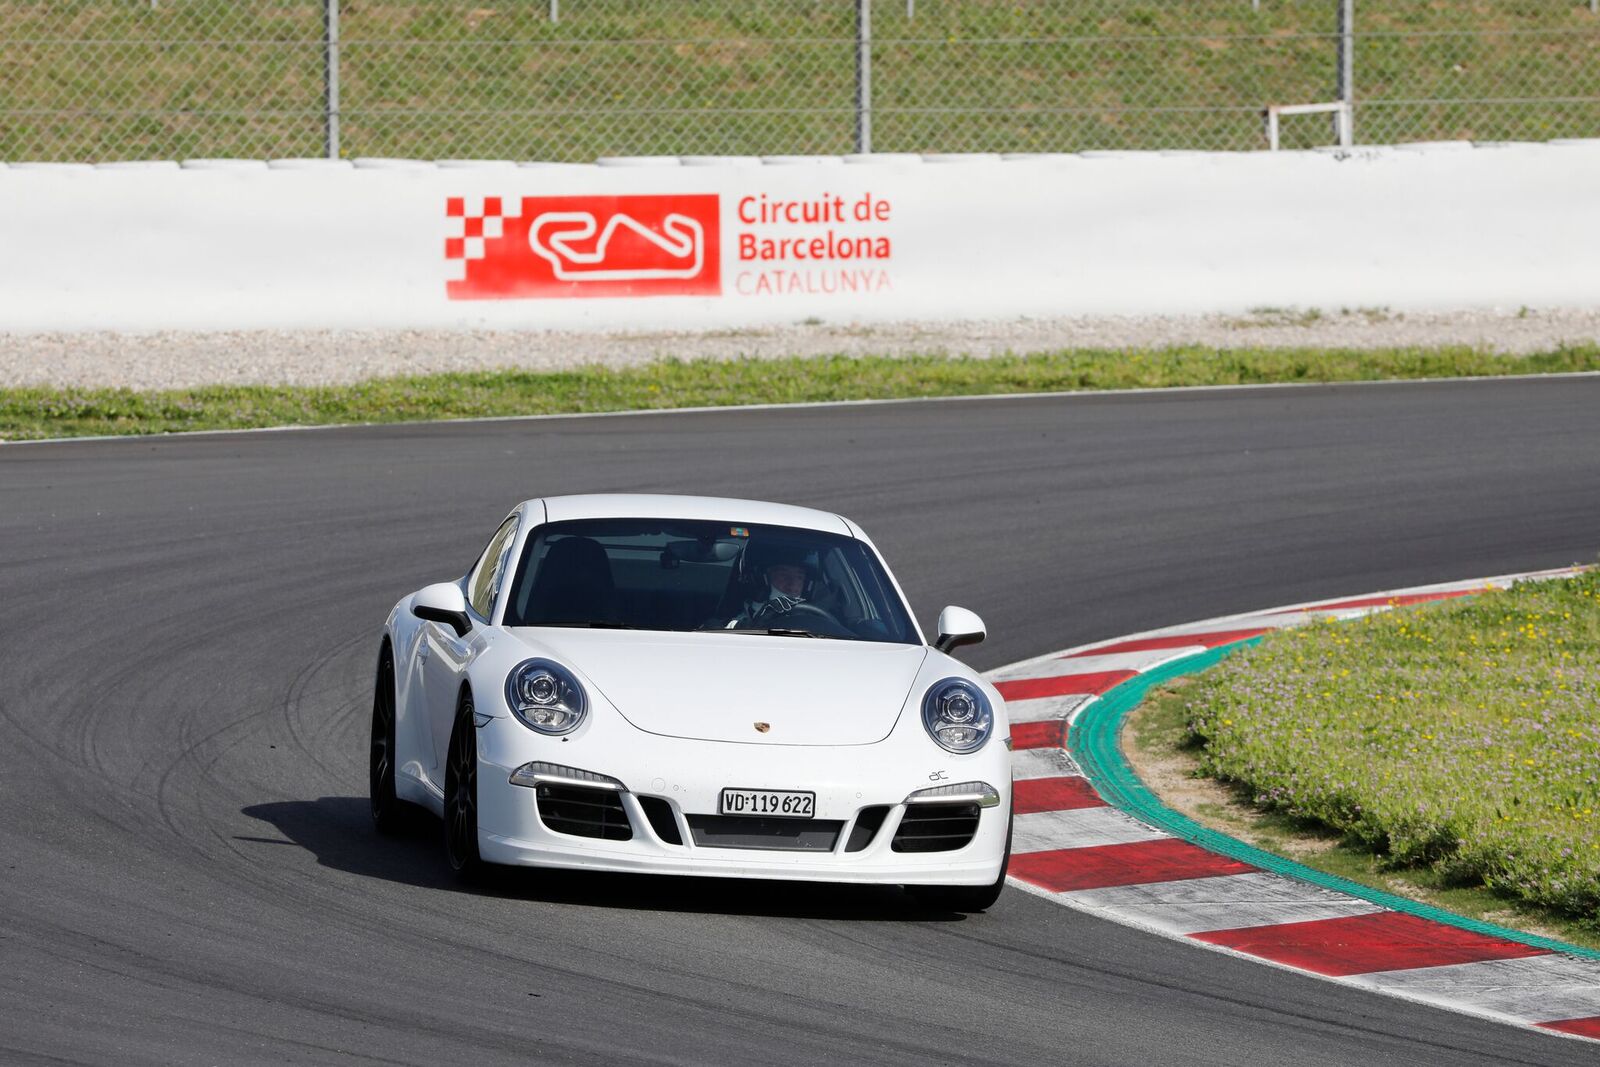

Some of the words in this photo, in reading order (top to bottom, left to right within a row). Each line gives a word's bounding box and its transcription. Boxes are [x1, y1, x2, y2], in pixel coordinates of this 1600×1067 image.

[738, 192, 844, 224] Circuit
[853, 192, 890, 221] de
[738, 230, 891, 261] Barcelona
[735, 269, 893, 296] CATALUNYA
